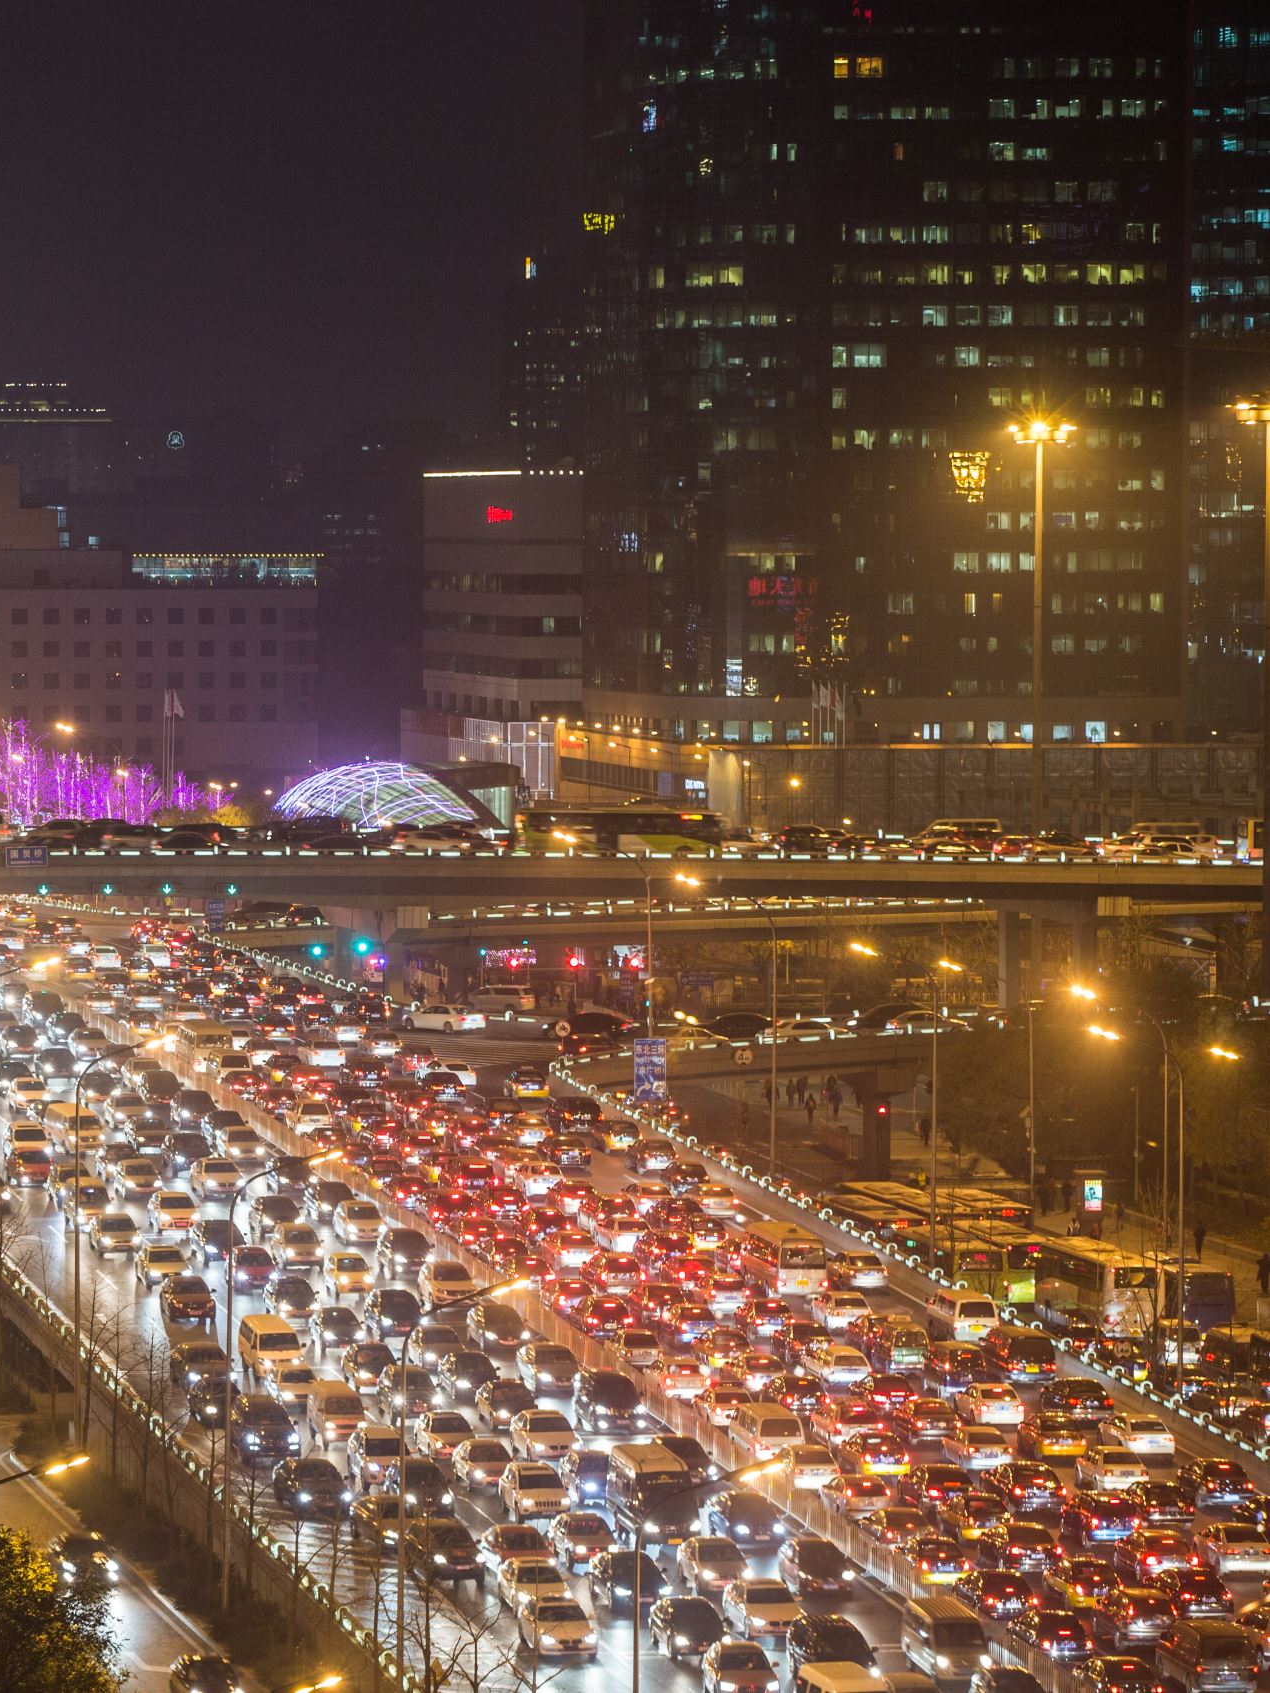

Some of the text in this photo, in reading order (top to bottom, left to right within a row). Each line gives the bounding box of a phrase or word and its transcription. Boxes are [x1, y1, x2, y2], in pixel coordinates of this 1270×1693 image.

[10, 849, 42, 858] 国贸桥
[635, 1045, 665, 1055] 东北三环
